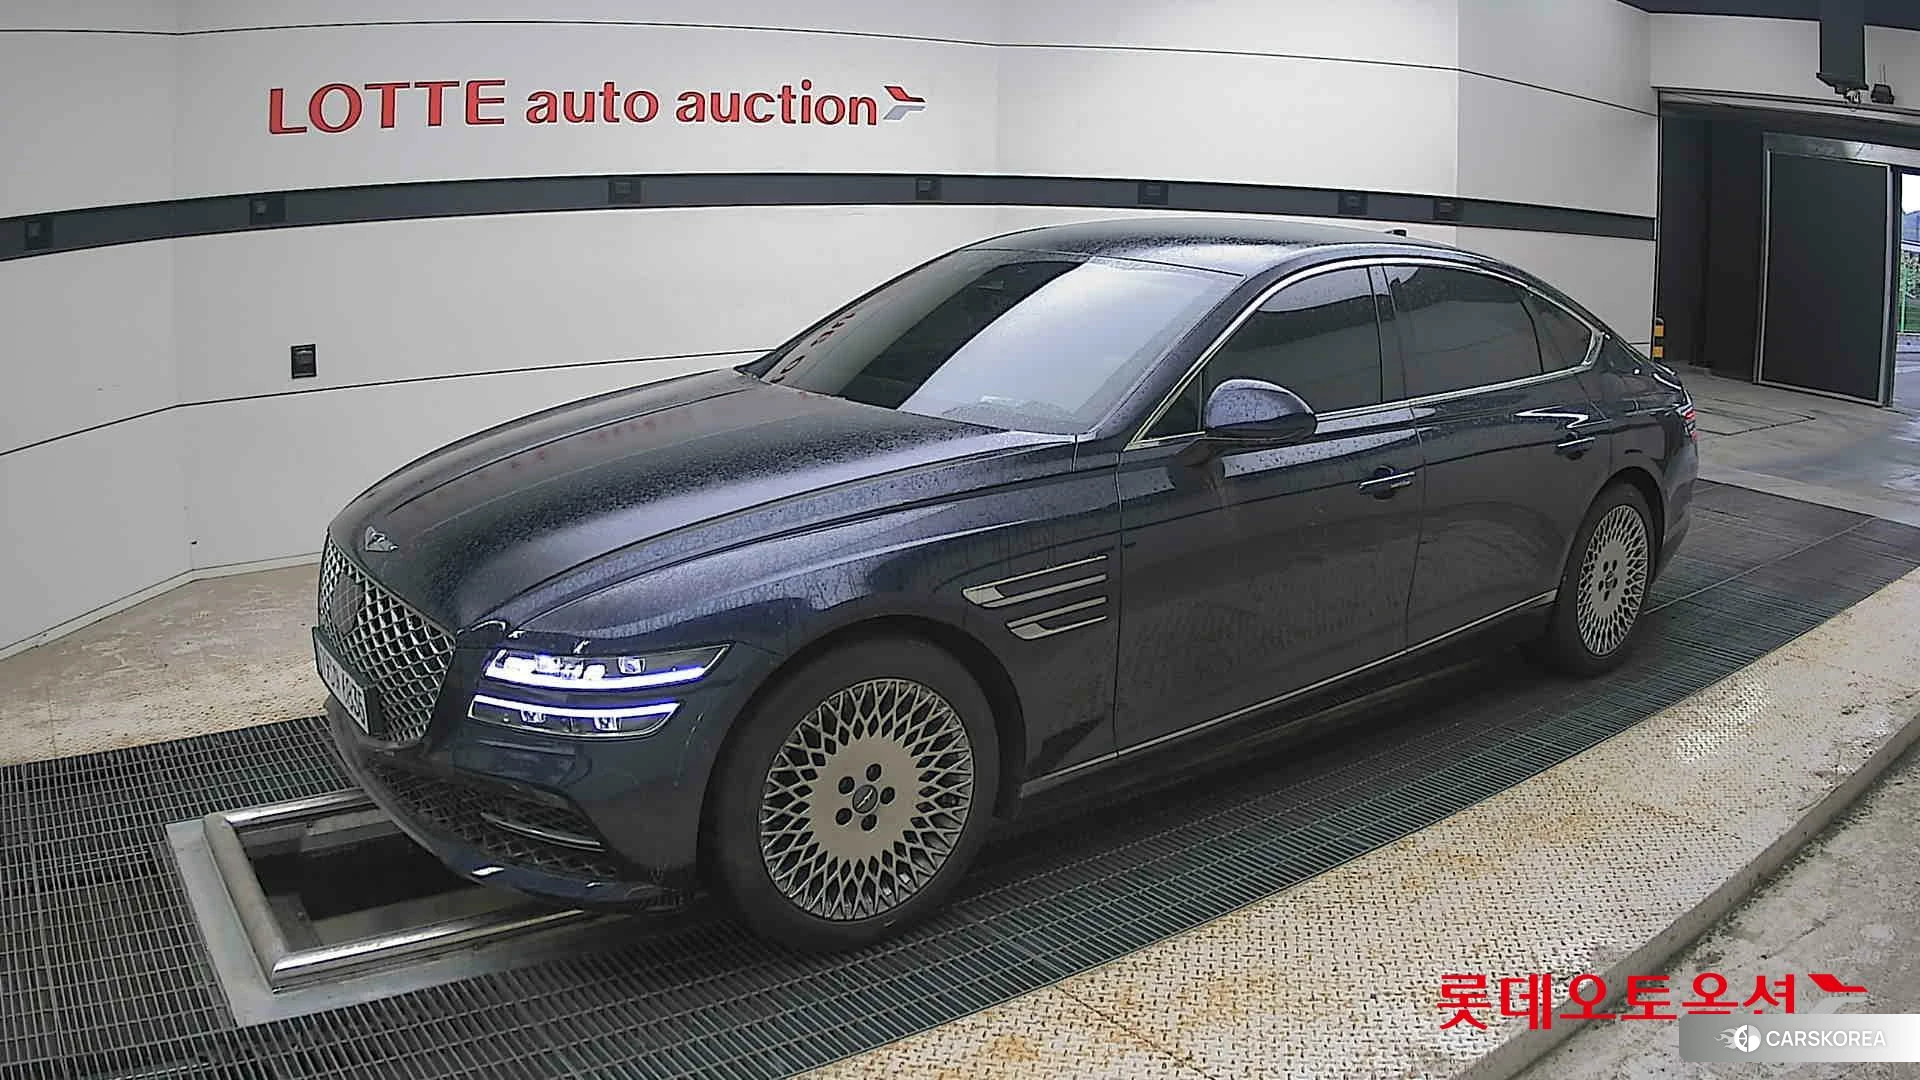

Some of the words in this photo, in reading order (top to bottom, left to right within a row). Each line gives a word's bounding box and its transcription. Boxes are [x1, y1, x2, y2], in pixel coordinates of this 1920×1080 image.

[269, 80, 506, 134] LOTTE
[526, 81, 659, 124] auto
[675, 79, 877, 126] auction
